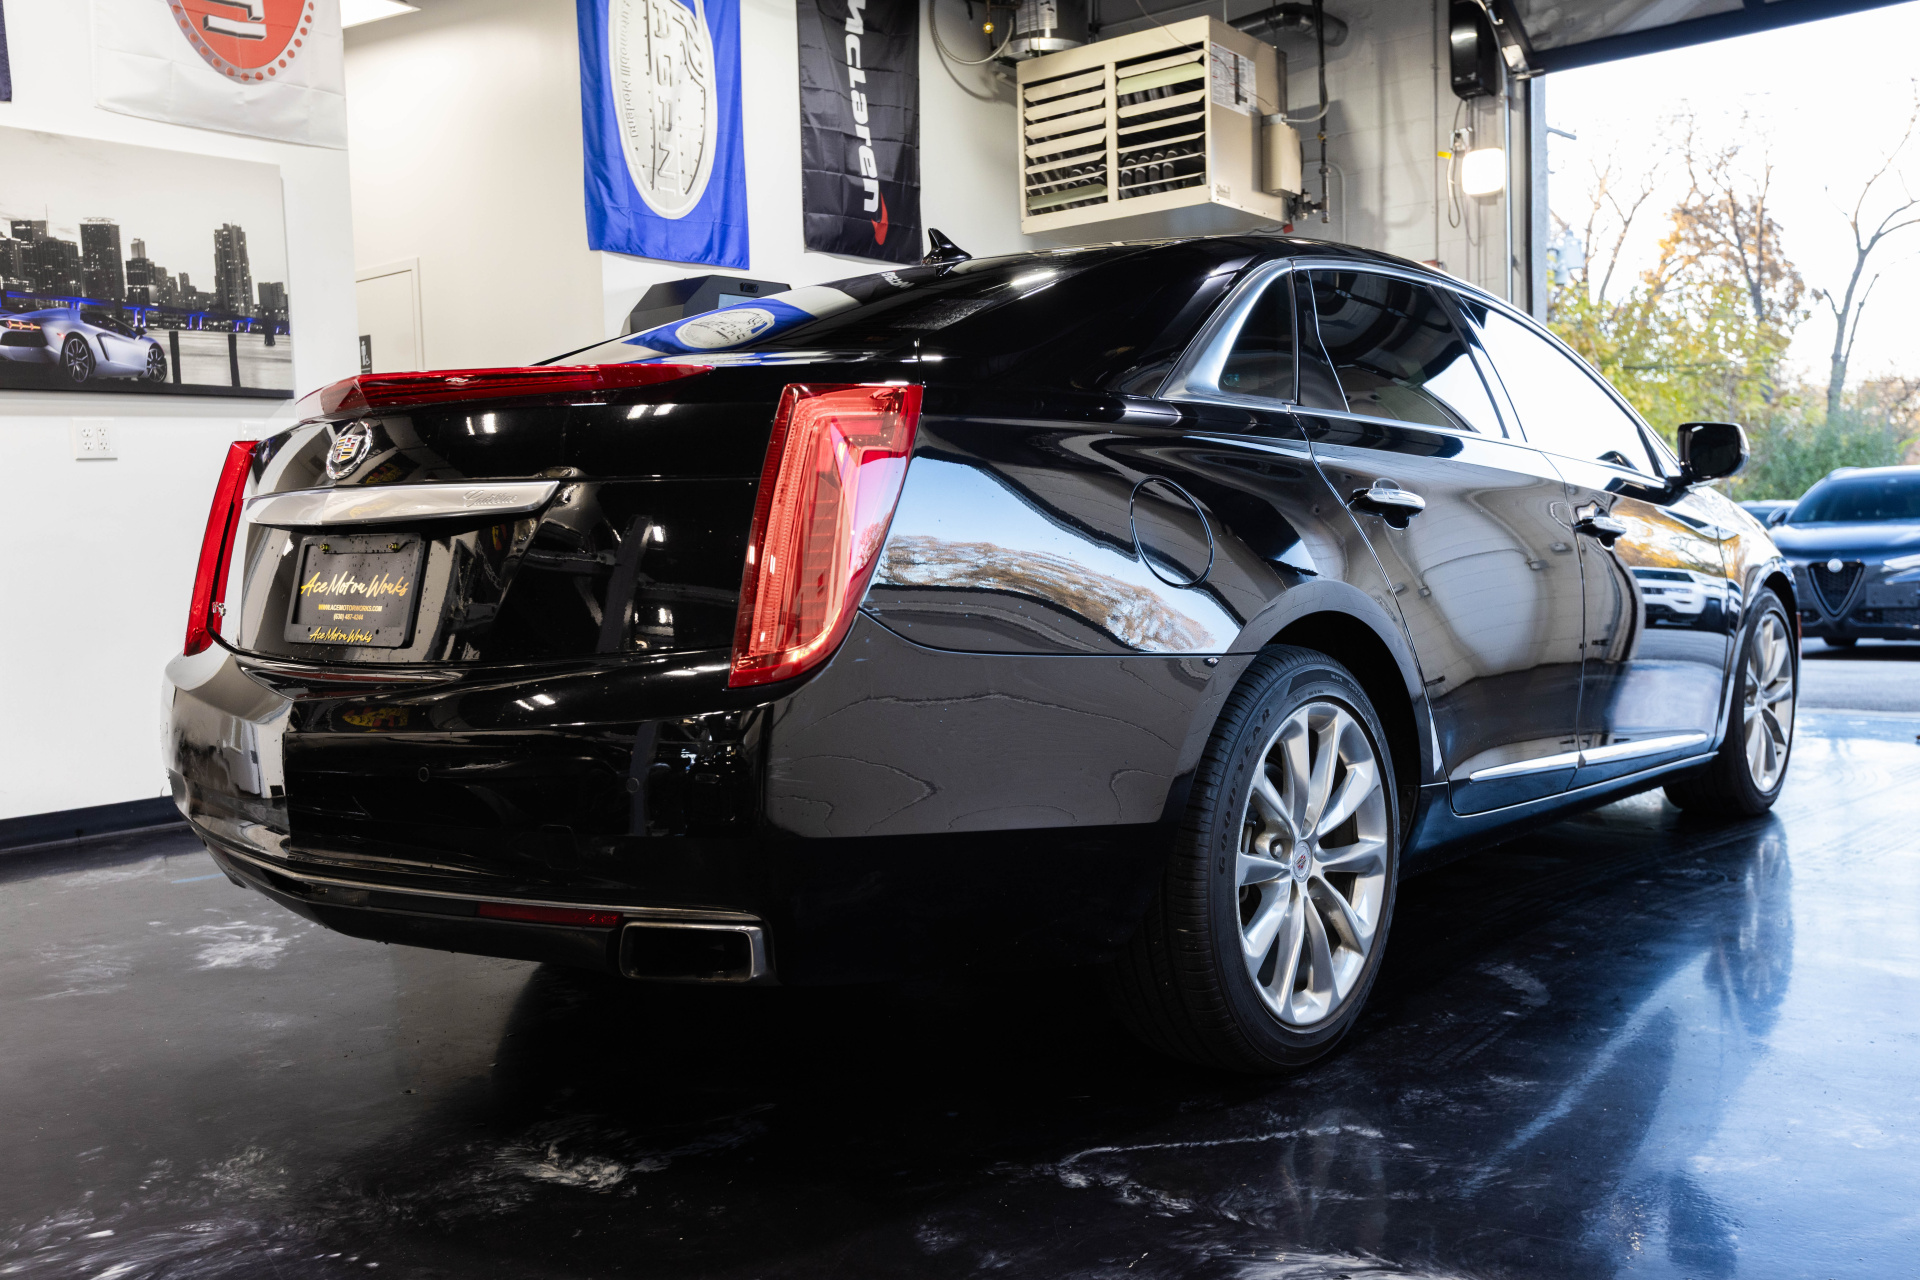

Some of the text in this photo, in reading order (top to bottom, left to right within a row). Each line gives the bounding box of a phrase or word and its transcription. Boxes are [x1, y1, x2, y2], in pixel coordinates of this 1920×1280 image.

[620, 0, 631, 77] utomobili
[652, 0, 677, 196] AGANI
[463, 490, 518, 508] Cadillac
[301, 571, 409, 598] Ace Motor Works
[309, 626, 374, 643] Ace Motor Works
[1218, 708, 1270, 876] GOODYEAR
